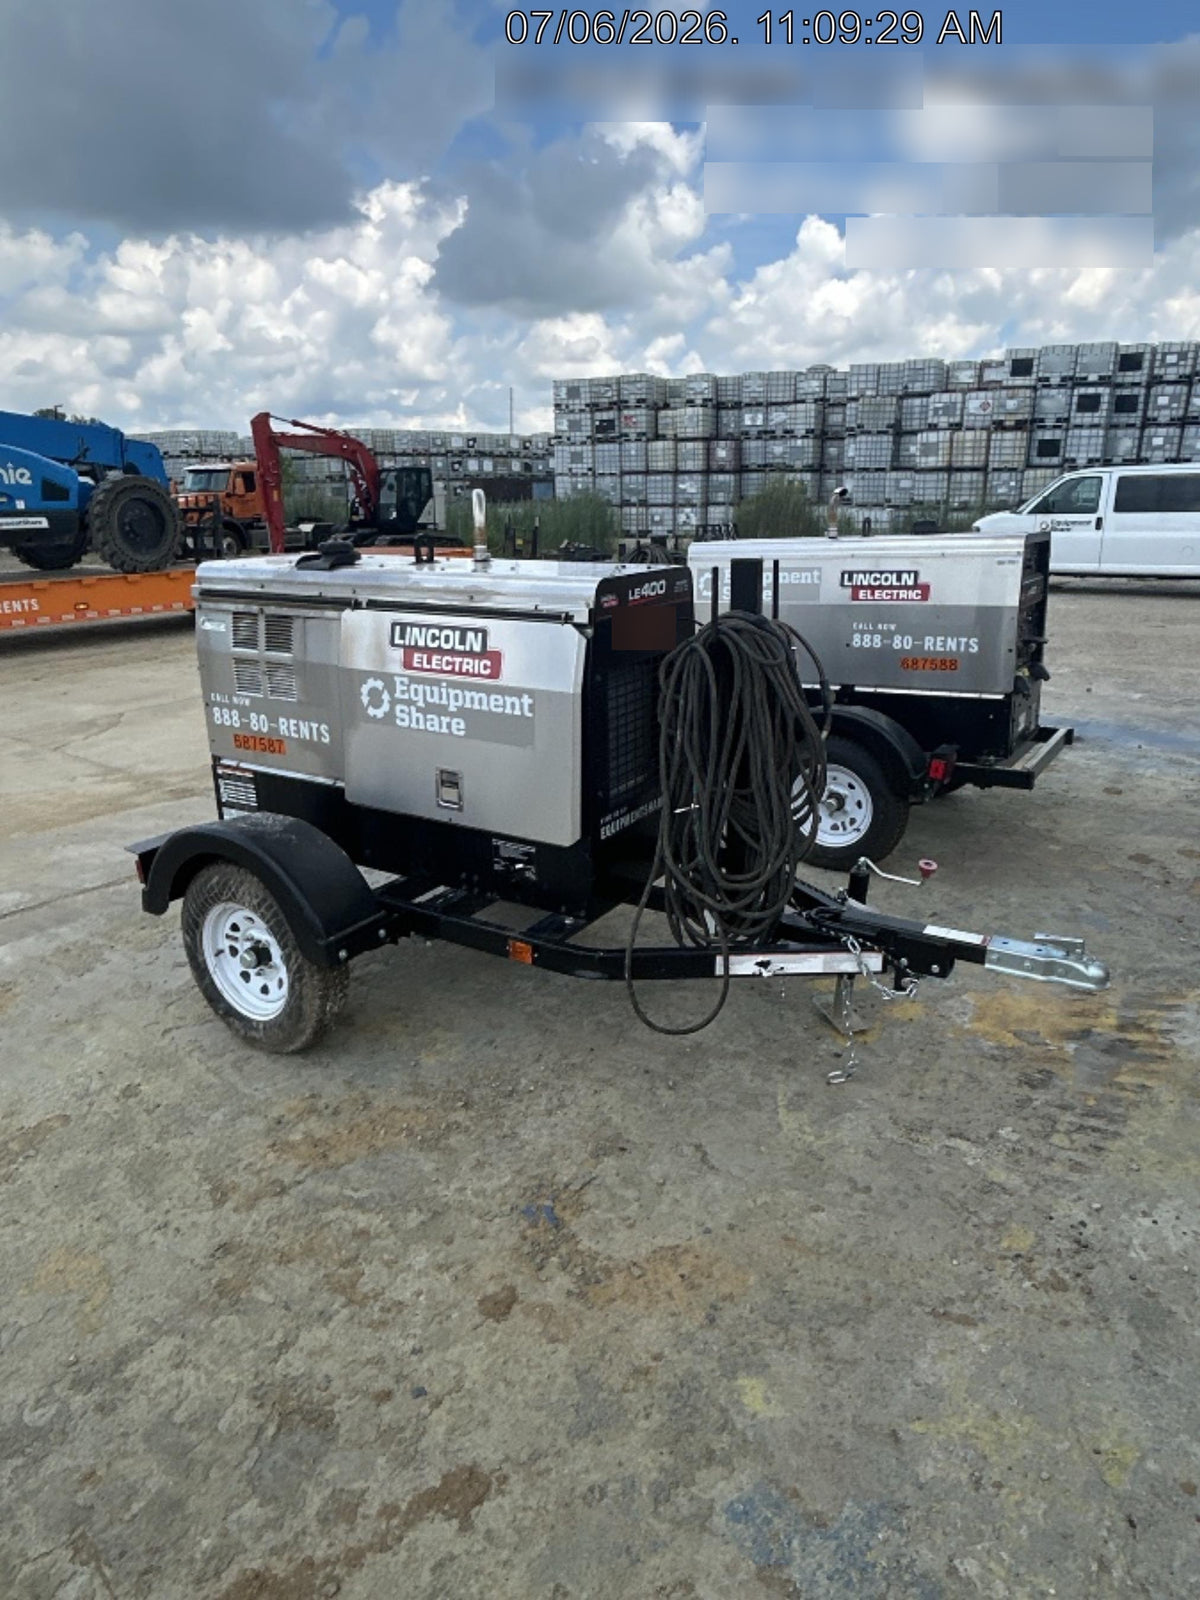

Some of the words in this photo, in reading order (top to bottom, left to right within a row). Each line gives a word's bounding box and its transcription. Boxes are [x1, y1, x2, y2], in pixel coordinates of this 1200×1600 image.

[843, 572, 915, 586] LINCOLN
[858, 589, 922, 600] ELECTRIC
[394, 625, 483, 652] LINCOLN
[852, 633, 979, 653] 888-80-RENTS
[413, 653, 492, 675] ELECTRIC
[901, 657, 958, 671] 687588
[394, 676, 534, 717] Equipment
[212, 706, 331, 744] 888-80-RENTS
[395, 704, 466, 736] Share
[233, 734, 285, 754] 687587
